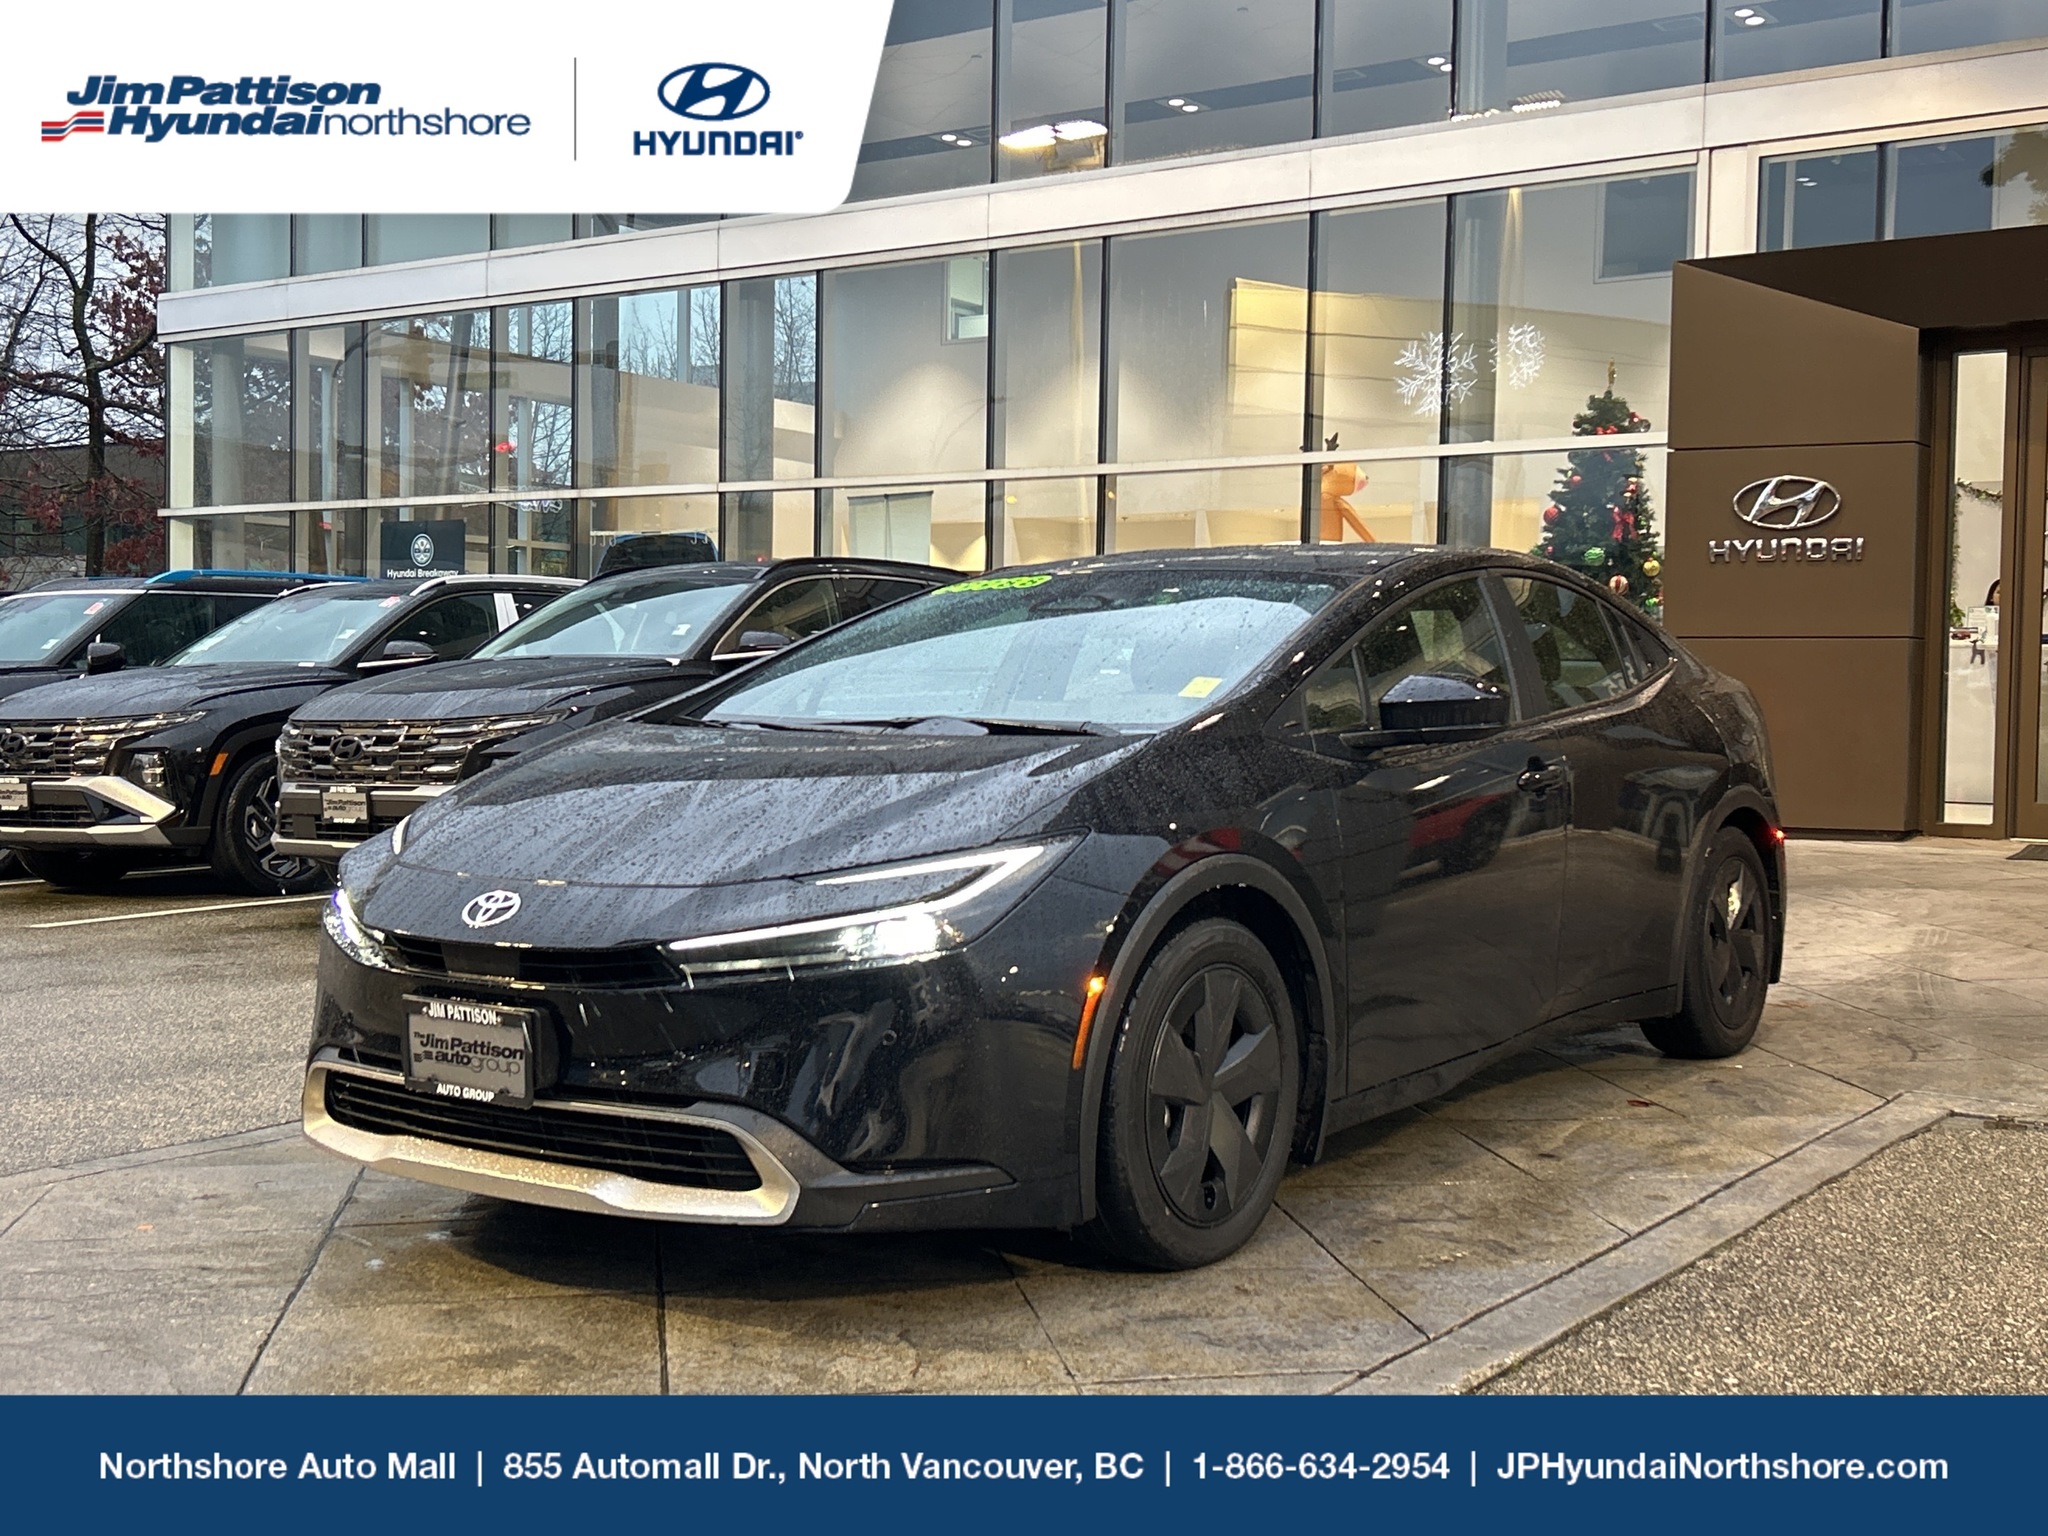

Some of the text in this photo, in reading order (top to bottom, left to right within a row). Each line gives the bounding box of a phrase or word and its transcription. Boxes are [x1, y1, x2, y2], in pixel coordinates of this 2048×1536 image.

[1709, 537, 1865, 564] HYUNDAI
[387, 568, 416, 580] Hyundai
[428, 1002, 497, 1026] JIM PATTISON
[436, 1083, 495, 1102] AUTO GROUP
